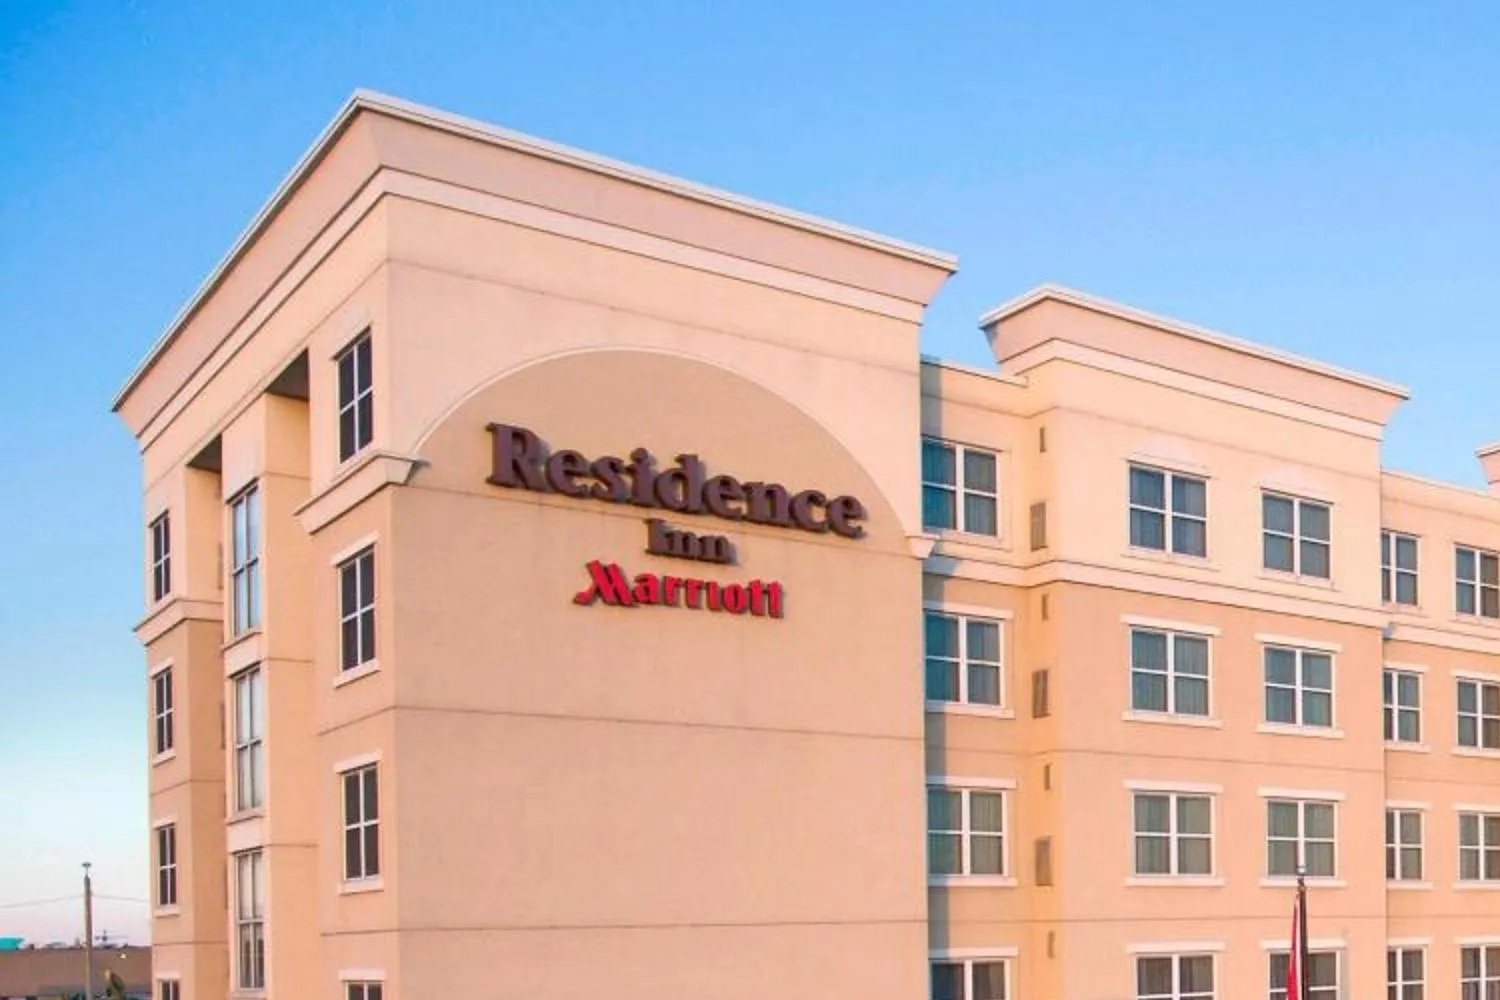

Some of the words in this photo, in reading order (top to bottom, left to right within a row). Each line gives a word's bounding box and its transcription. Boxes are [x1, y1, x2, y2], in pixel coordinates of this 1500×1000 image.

[486, 422, 868, 538] Residence
[643, 517, 738, 565] Inn
[573, 559, 784, 619] Marriott
